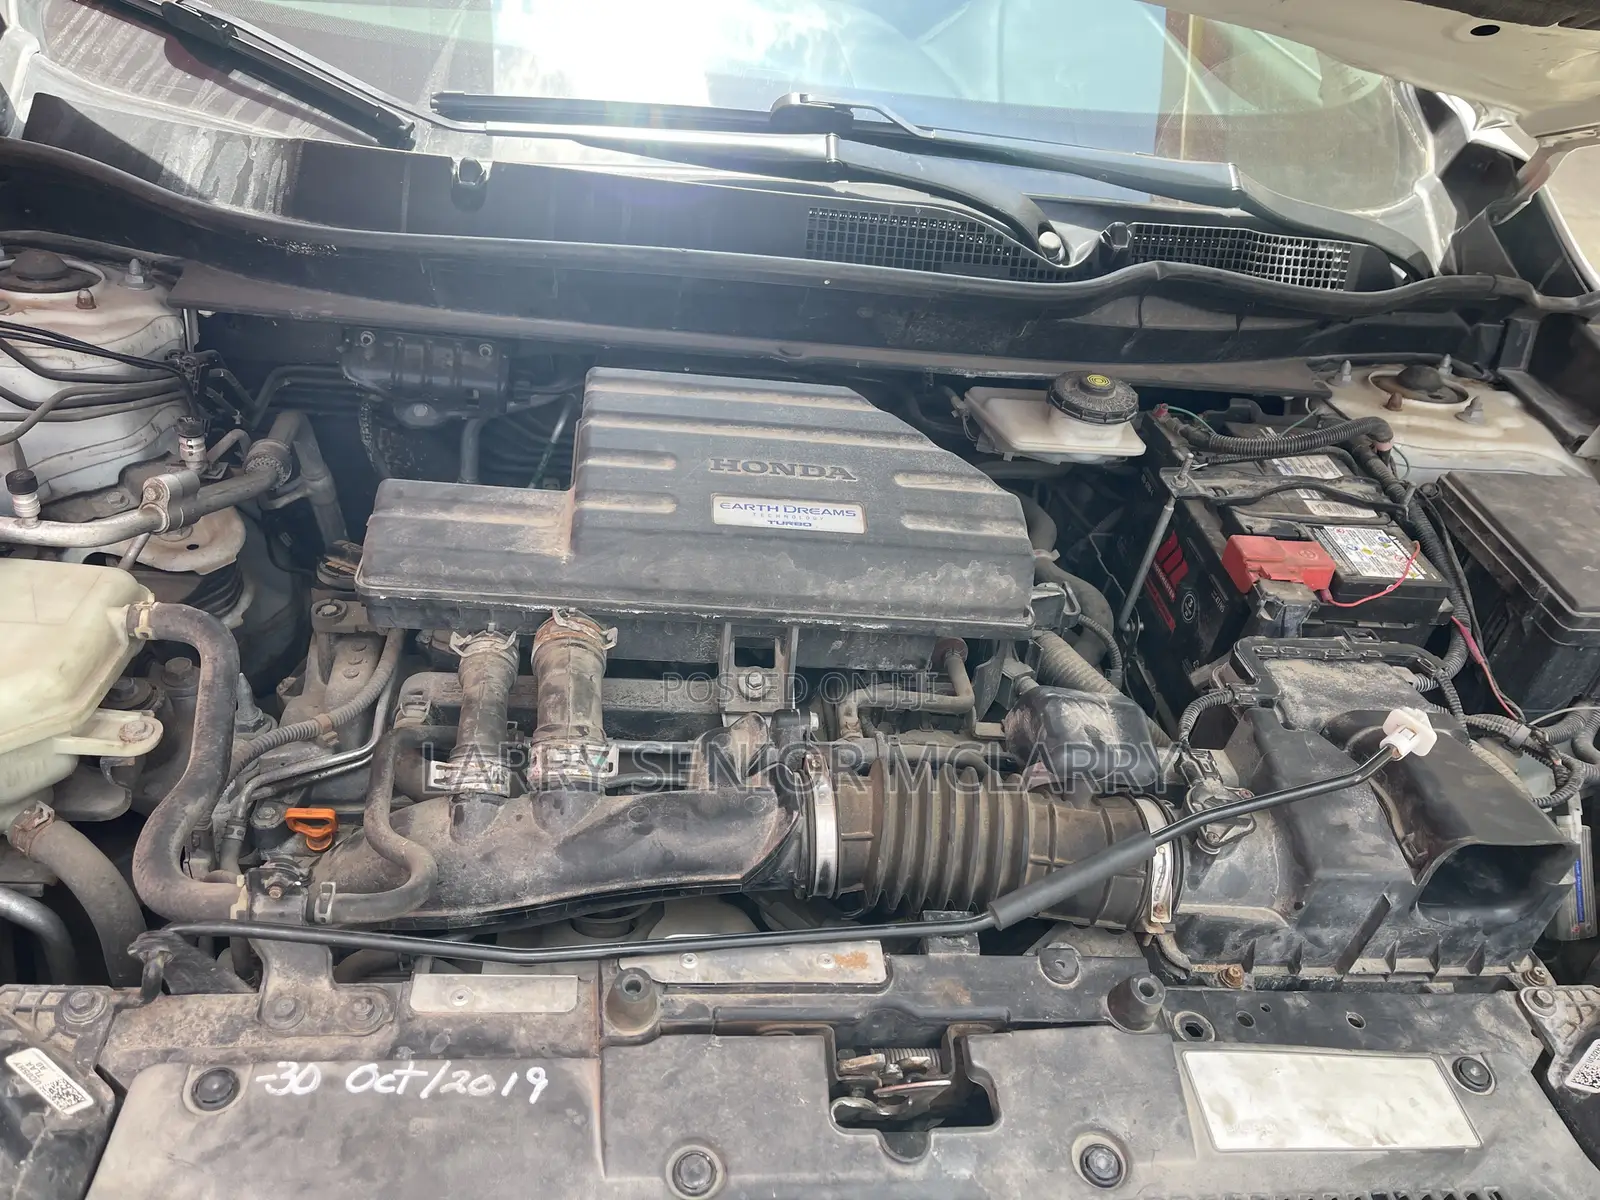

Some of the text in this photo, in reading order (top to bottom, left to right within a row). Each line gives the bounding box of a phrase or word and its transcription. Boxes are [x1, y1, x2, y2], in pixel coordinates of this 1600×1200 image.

[710, 458, 857, 481] HONDA
[720, 502, 856, 517] EARTH DREAMS
[753, 512, 824, 521] TECHNOLOGY
[767, 519, 812, 527] TURBO
